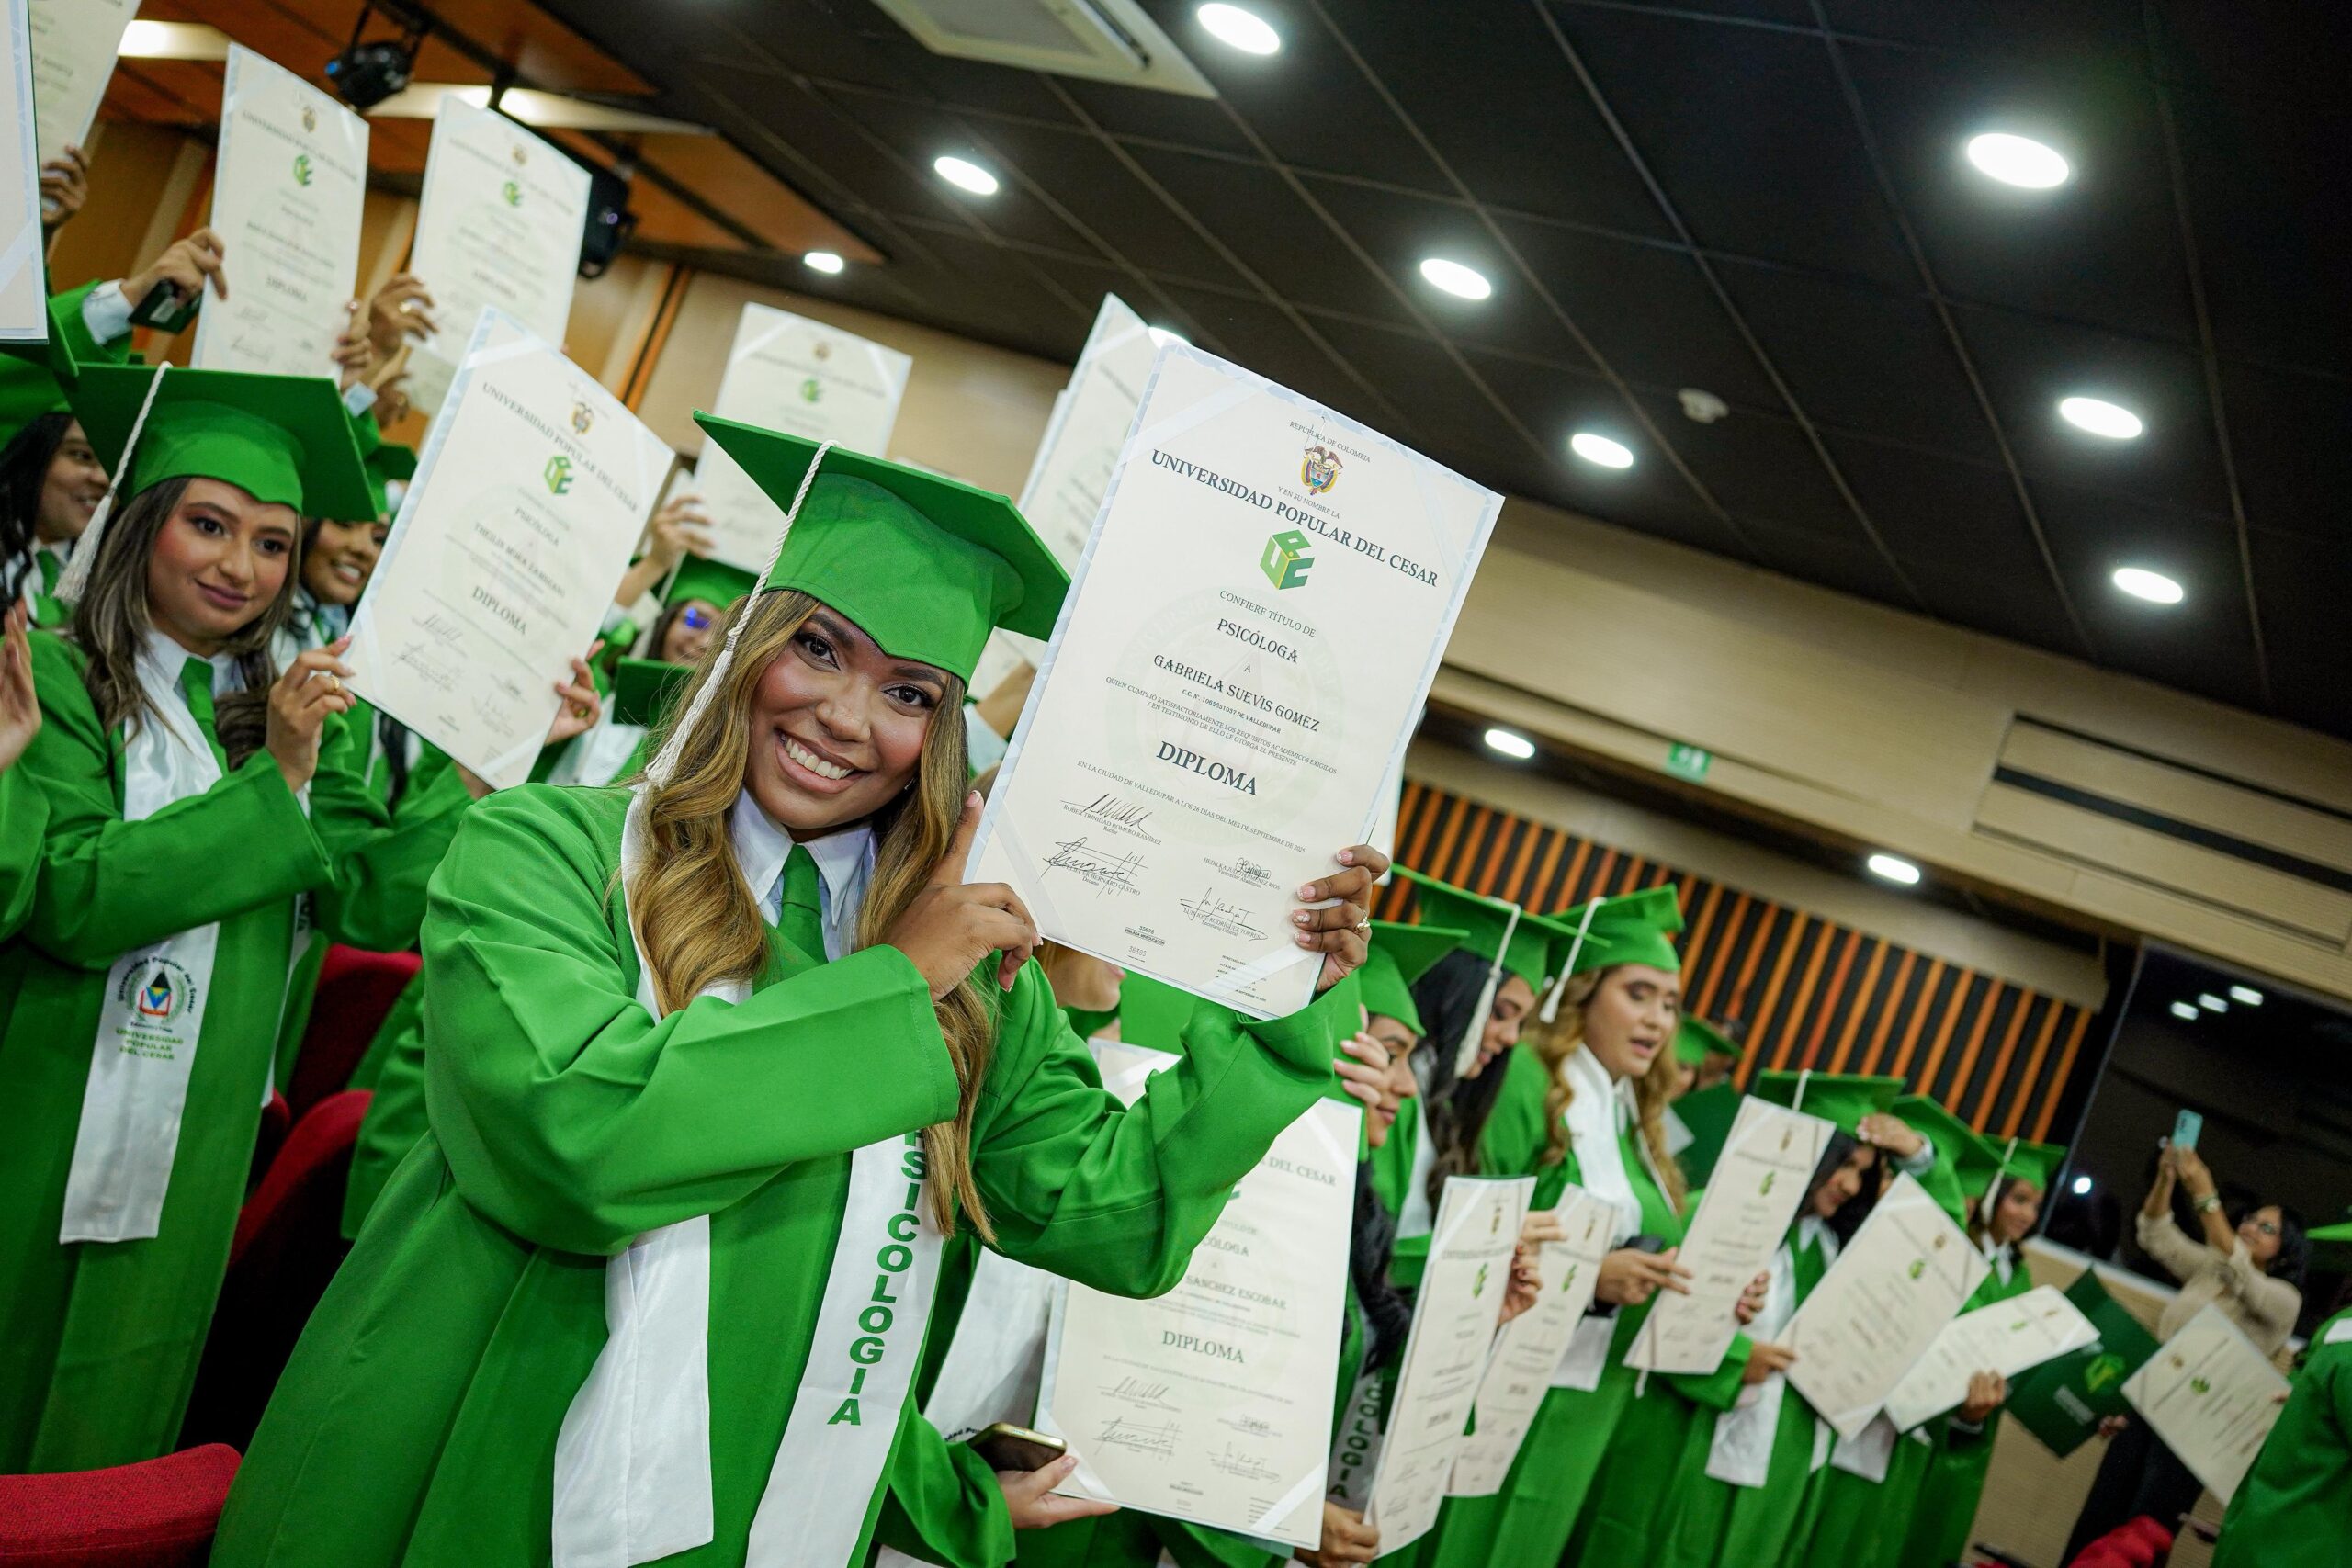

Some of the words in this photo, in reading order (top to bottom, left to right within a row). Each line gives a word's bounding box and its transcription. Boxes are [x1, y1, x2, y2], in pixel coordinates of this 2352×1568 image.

[482, 381, 554, 439] UNIVERSIDAD
[553, 434, 597, 474] POPULAR
[1326, 437, 1337, 446] DE
[1336, 442, 1371, 463] COLOMBIA
[1151, 448, 1273, 510] UNIVERSIDAD
[1273, 501, 1351, 547] POPULAR
[1353, 536, 1385, 562] DEL
[1389, 554, 1438, 587] CESAR
[1283, 489, 1293, 497] EN
[1293, 493, 1302, 502] SU
[1302, 497, 1330, 514] NOMBRE
[1330, 511, 1340, 519] LA
[472, 585, 526, 635] DIPLOMA
[1219, 590, 1267, 616] CONFIERE
[1268, 610, 1302, 631] TÍTULO
[1301, 625, 1316, 637] DE
[1216, 618, 1298, 663] PSICÓLOGA
[1244, 664, 1251, 672] A
[1153, 654, 1224, 693] GABRIELA
[1226, 684, 1273, 712] SUEVIS
[1274, 705, 1320, 732] GOMEZ
[1105, 676, 1127, 689] QUIEN
[1157, 696, 1224, 728] SATISFACTORIAMENTE
[1227, 726, 1236, 734] LOS
[1235, 728, 1271, 748] REQUISITOS
[1309, 759, 1337, 774] EXIGIDOS
[1150, 702, 1161, 711] EN
[1161, 705, 1199, 727] TESTIMONIO
[1199, 721, 1208, 730] DE
[1208, 726, 1226, 737] ELLO
[1225, 732, 1234, 740] LE
[1233, 736, 1259, 751] OTORGA
[1259, 746, 1267, 754] EL
[1267, 750, 1297, 766] PRESENTE
[1245, 714, 1282, 734] VALLEDUPAR
[1156, 740, 1257, 796] DIPLOMA
[1077, 760, 1087, 768] EN
[1087, 763, 1097, 773] LA
[1097, 768, 1124, 783] CIUDAD
[1123, 778, 1133, 786] DE
[1134, 781, 1175, 803] VALLEDUPAR
[1180, 800, 1193, 810] LOS
[1199, 807, 1216, 818] DÍAS
[1215, 814, 1227, 822] DEL
[1227, 818, 1240, 829] MES
[1240, 823, 1250, 831] DE
[1249, 828, 1284, 846] SEPTIEMBRE
[1284, 840, 1294, 849] DE
[1083, 810, 1111, 828] TRINIDAD
[1111, 822, 1136, 836] ROMERO
[1102, 825, 1117, 835] Rector
[1117, 883, 1140, 897] CASTRO
[1270, 1156, 1293, 1173] DEL
[1295, 1165, 1336, 1186] CESAR
[1186, 1274, 1235, 1295] SANCHEZ
[1161, 1329, 1244, 1363] DIPLOMA
